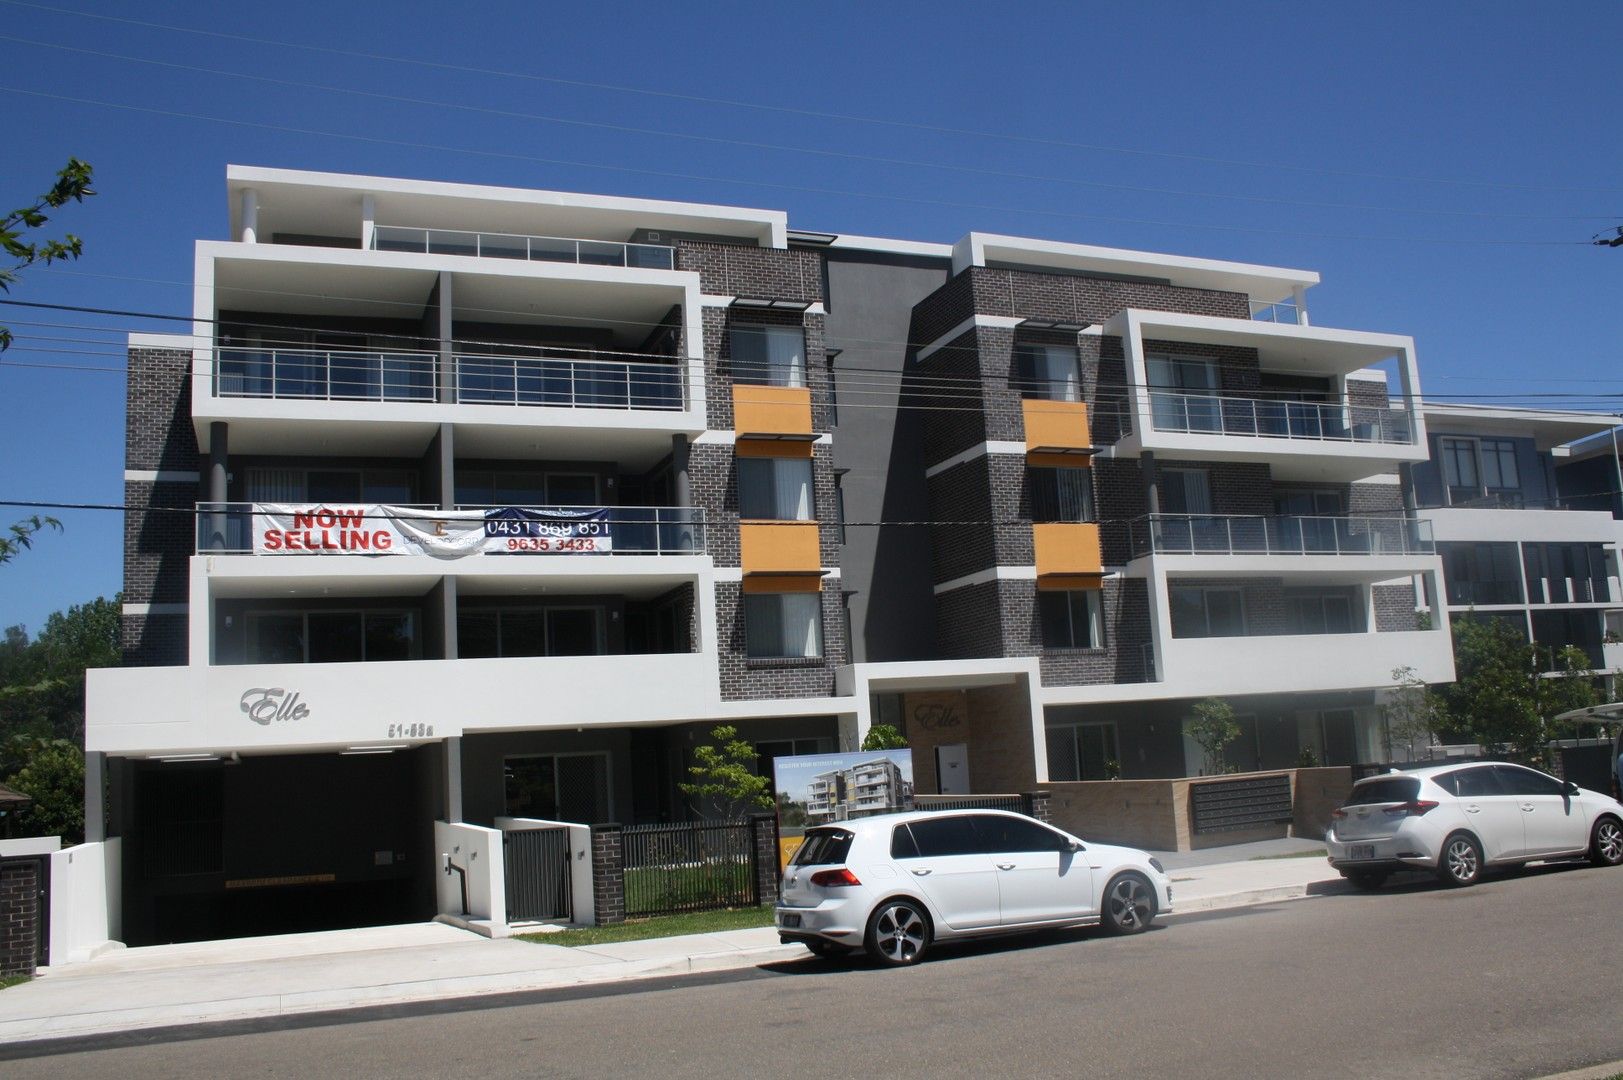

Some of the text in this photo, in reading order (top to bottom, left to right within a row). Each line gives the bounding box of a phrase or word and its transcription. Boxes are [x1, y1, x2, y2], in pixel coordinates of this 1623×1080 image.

[293, 509, 364, 529] NOW
[487, 518, 530, 534] 0431
[578, 518, 609, 534] 851
[263, 529, 392, 550] SELLING
[507, 538, 595, 551] 9635 3433
[240, 687, 310, 726] Elle
